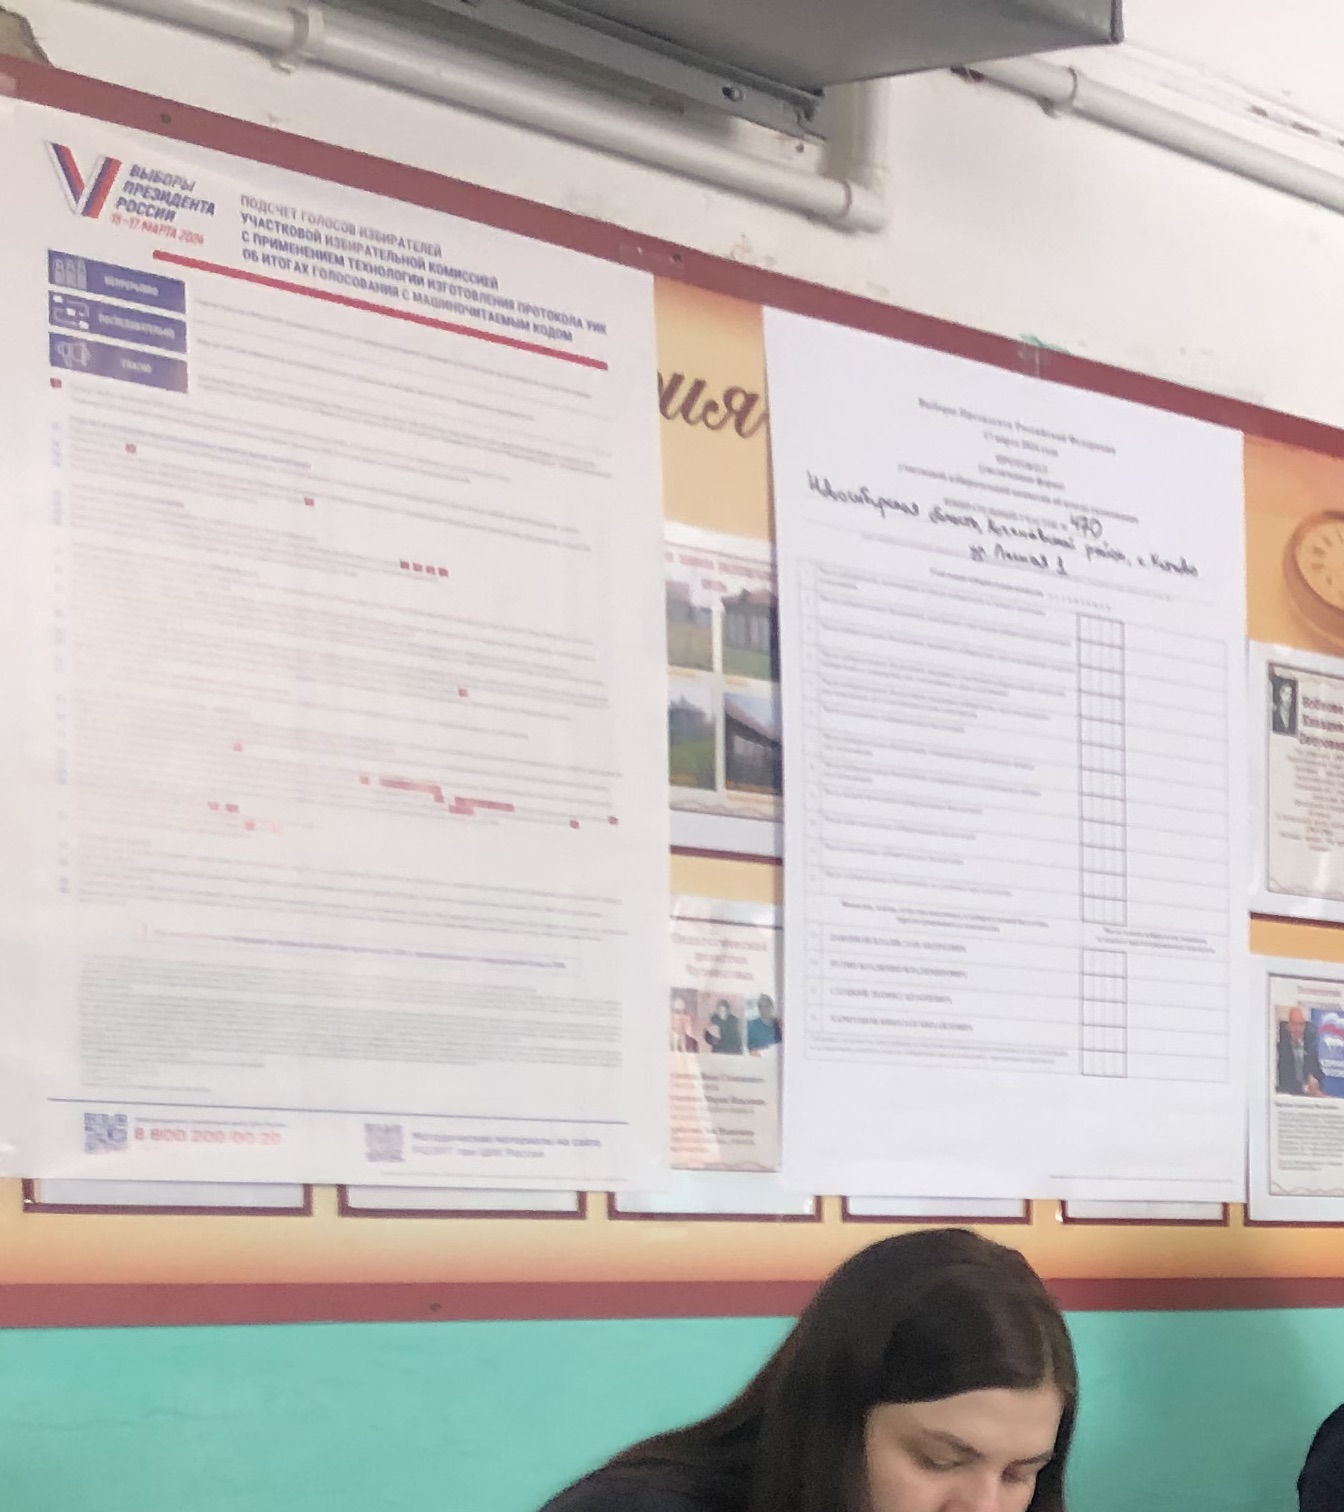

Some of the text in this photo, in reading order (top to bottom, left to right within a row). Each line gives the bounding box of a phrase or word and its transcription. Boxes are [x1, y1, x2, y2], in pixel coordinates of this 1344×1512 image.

[122, 180, 216, 216] ПРЕЗИДЕНТА
[129, 163, 197, 193] ВЫБОРЫ
[115, 196, 178, 222] РОССИИ
[141, 220, 177, 240] МАРТА
[240, 194, 443, 259] ПОДСЧЕТ ГОЛОСОВ ИЗБИРАТЕЛЕЙ
[240, 211, 499, 290] УЧАСТКОВОЙ ИЗБИРАТЕЛЬНОЙ КОМИССИЕЙ
[242, 248, 259, 263] ОБ
[262, 251, 310, 275] ИТОГАХ
[312, 265, 400, 299] ГОЛОСОВАНИЯ
[412, 290, 530, 332] МАШИНОЧИТАЕМЫМ
[533, 322, 574, 343] КОДОМ
[252, 232, 345, 267] ПРИМЕНЕНИЕМ
[348, 256, 425, 287] ТЕХНОЛОГИИ
[427, 277, 515, 312] ИЗГОТОВЛЕНИЯ
[517, 300, 583, 330] ПРОТОКОЛА
